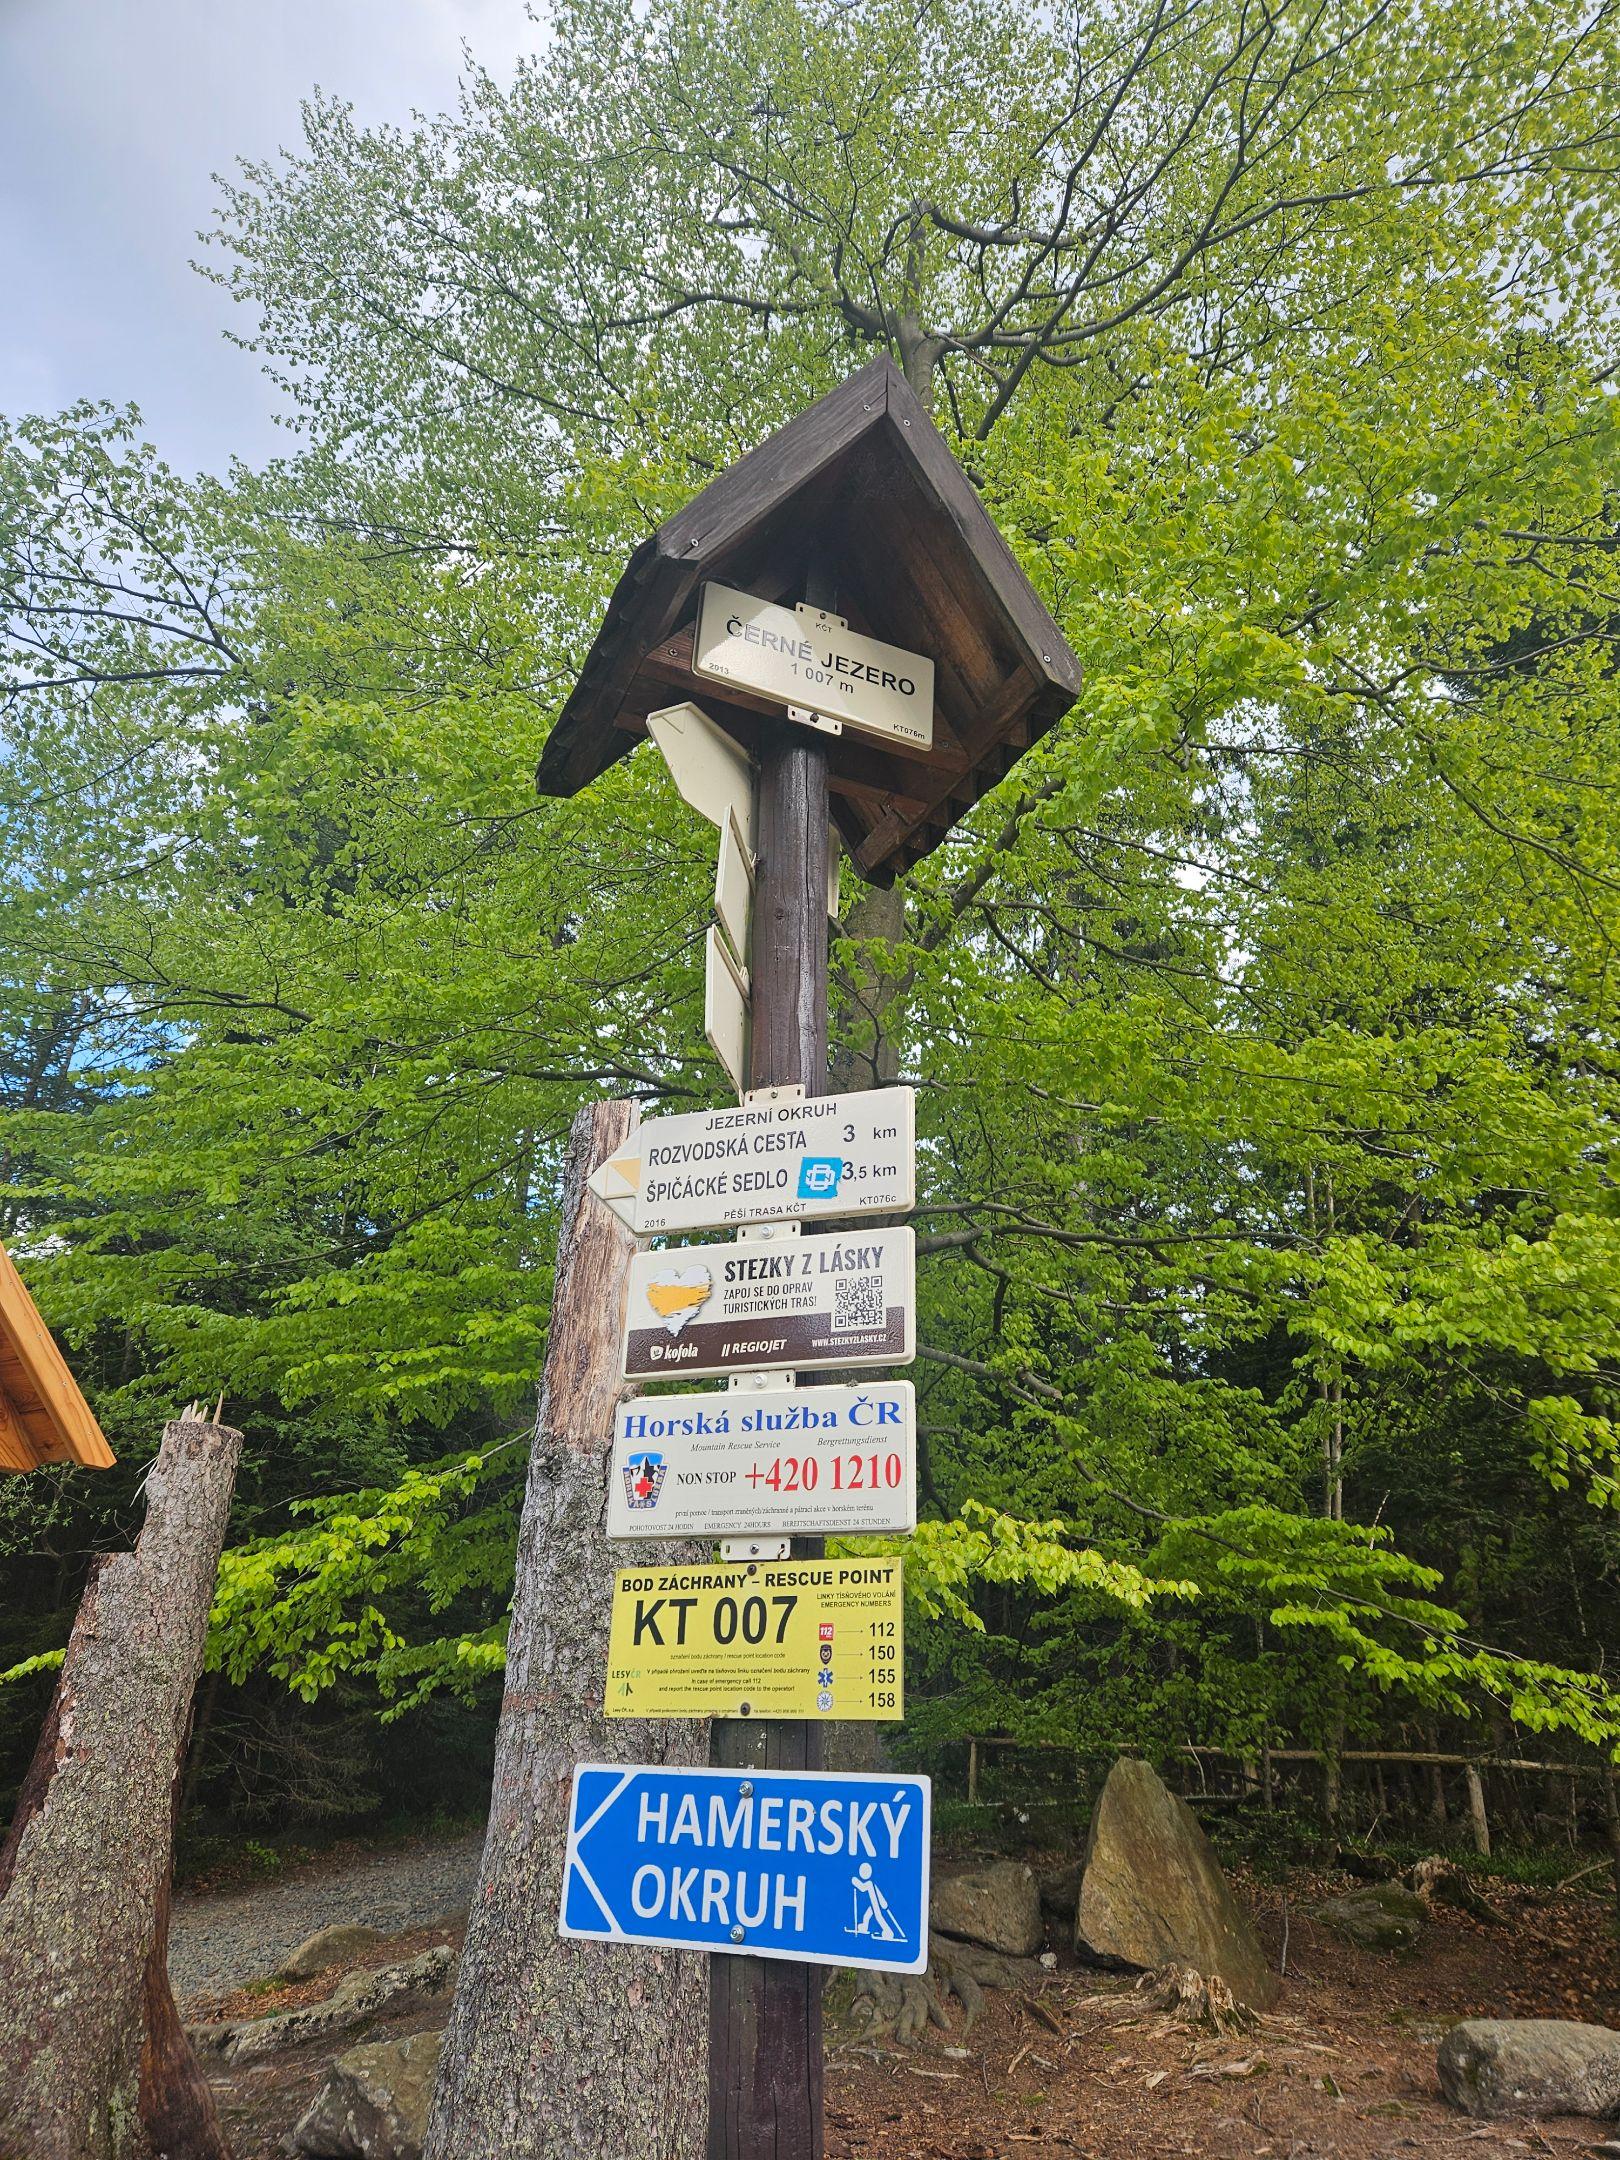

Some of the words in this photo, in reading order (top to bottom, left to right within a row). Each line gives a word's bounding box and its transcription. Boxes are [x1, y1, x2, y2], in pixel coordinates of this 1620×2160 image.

[816, 622, 832, 633] KČT
[726, 615, 813, 662] ČERNÉ
[821, 652, 915, 696] JEZERO
[708, 662, 729, 676] 2013
[791, 663, 798, 675] 1
[806, 666, 833, 686] 007
[840, 682, 854, 694] m
[705, 1109, 773, 1131] JEZERNÍ
[777, 1102, 837, 1121] OKRUH
[649, 1132, 747, 1167] ROZVODSKÁ
[752, 1130, 807, 1154] CESTA
[843, 1124, 856, 1143] 3
[873, 1126, 897, 1140] km
[646, 1171, 728, 1203] ŠPIČÁCKÉ
[733, 1168, 788, 1193] SEDLO
[842, 1161, 867, 1182] 3,5
[872, 1164, 897, 1179] km
[858, 1194, 897, 1206] KT076c
[724, 1206, 747, 1220] PĚŠÍ
[748, 1205, 784, 1218] TRASA
[786, 1201, 807, 1215] KČT
[644, 1218, 666, 1229] 2016
[724, 1254, 795, 1283] STEZKY
[802, 1254, 812, 1275] Z
[819, 1244, 885, 1273] LÁSKY
[724, 1285, 751, 1301] ZAPOJ
[754, 1286, 764, 1298] SE
[766, 1284, 780, 1297] DO
[782, 1282, 813, 1295] OPRAV
[724, 1297, 788, 1315] TURISTICKÝCH
[790, 1296, 817, 1309] TRAS!
[664, 1342, 699, 1363] kofola
[732, 1339, 788, 1355] REGIOJET
[622, 1409, 730, 1439] Horská
[740, 1405, 838, 1433] služba
[848, 1396, 903, 1427] ČR
[690, 1442, 726, 1452] Mountain
[728, 1442, 753, 1450] Rescue
[754, 1440, 781, 1449] Service
[816, 1435, 888, 1448] Bergrettungsdienst
[676, 1473, 704, 1486] NON
[705, 1470, 737, 1485] STOP
[744, 1456, 819, 1493] +420
[830, 1453, 902, 1490] 1210
[622, 1578, 655, 1592] BOD
[658, 1574, 748, 1591] ZÁCHRANY
[765, 1570, 833, 1588] RESCUE
[839, 1569, 894, 1585] POINT
[816, 1592, 835, 1600] LINKY
[874, 1590, 896, 1599] VOLÁNÍ
[821, 1600, 860, 1609] EMERGENCY
[860, 1600, 892, 1608] NUMBERS
[633, 1597, 698, 1646] KT
[713, 1596, 798, 1646] 007
[870, 1622, 895, 1637] 112
[869, 1645, 895, 1661] 150
[869, 1668, 896, 1684] 155
[869, 1692, 896, 1708] 158
[637, 1790, 912, 1860] HAMERSKÝ
[631, 1864, 807, 1932] OKRUH
